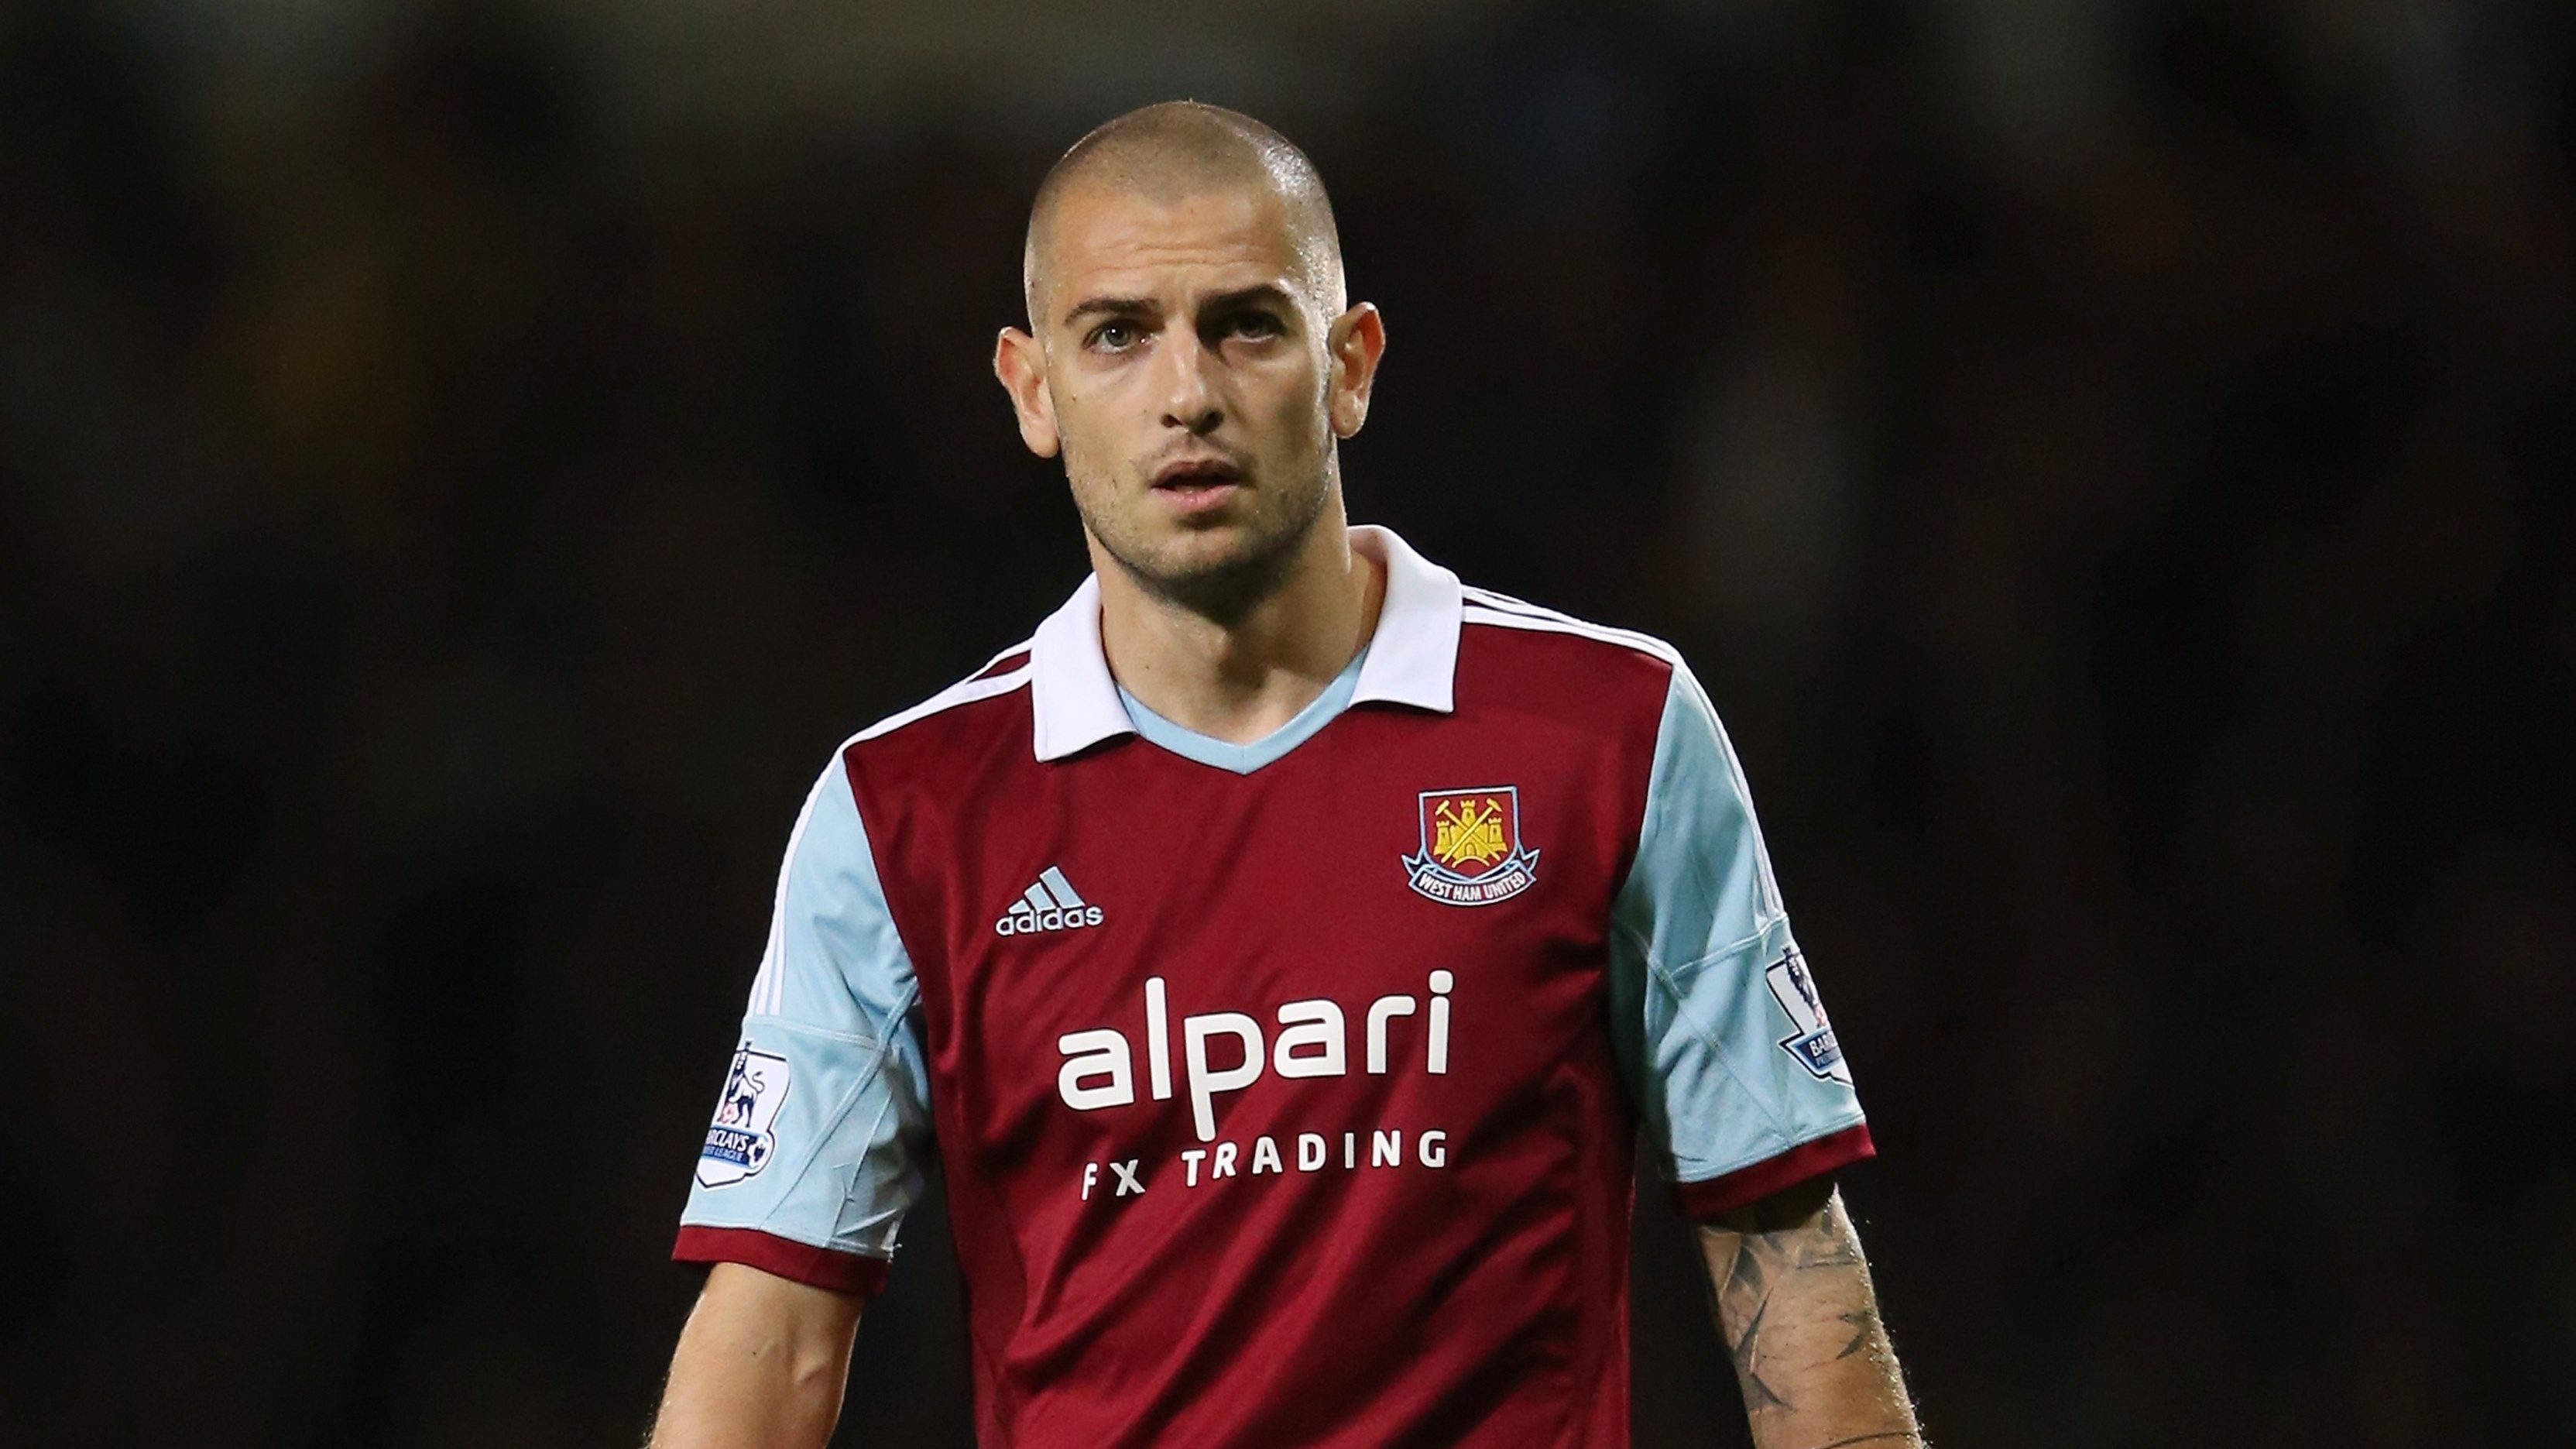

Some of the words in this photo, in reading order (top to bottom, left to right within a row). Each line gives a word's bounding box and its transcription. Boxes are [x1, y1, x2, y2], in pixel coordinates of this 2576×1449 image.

[1418, 873, 1453, 898] WEST
[1453, 885, 1482, 901] HAM
[1483, 871, 1526, 899] UNITED
[996, 906, 1104, 936] adidas
[1058, 970, 1454, 1142] alpari
[1081, 1159, 1145, 1200] FX
[1181, 1129, 1446, 1186] TRADING
